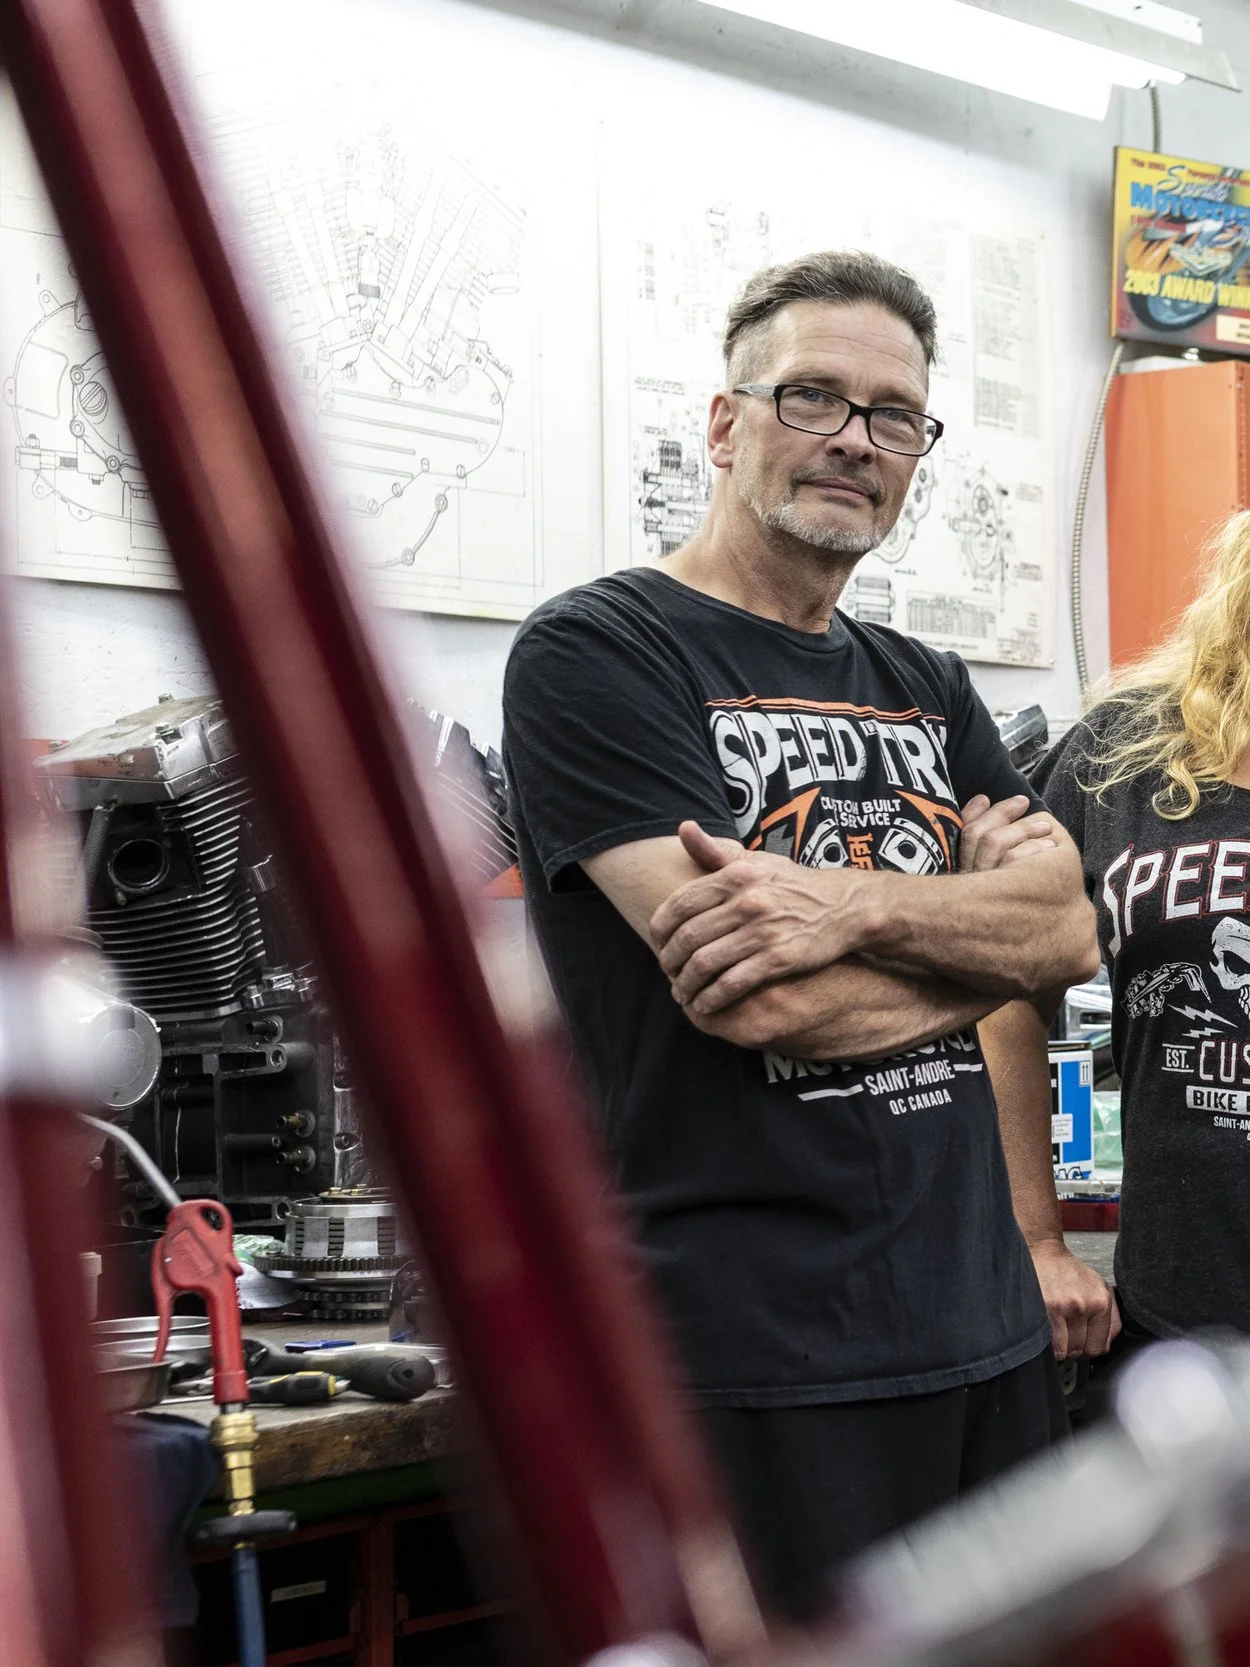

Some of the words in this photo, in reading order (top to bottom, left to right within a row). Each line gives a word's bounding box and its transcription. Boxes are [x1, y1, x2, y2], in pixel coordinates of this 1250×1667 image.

[1123, 268, 1161, 296] 2003
[1160, 274, 1216, 305] AWARD
[709, 709, 868, 839] SPEED
[861, 799, 901, 814] BUILT
[1165, 1048, 1190, 1070] EST.
[864, 1059, 956, 1096] SAINT-ANDRE
[889, 1098, 907, 1115] QC
[907, 1088, 952, 1112] CANADA
[1192, 1089, 1239, 1112] BIKE
